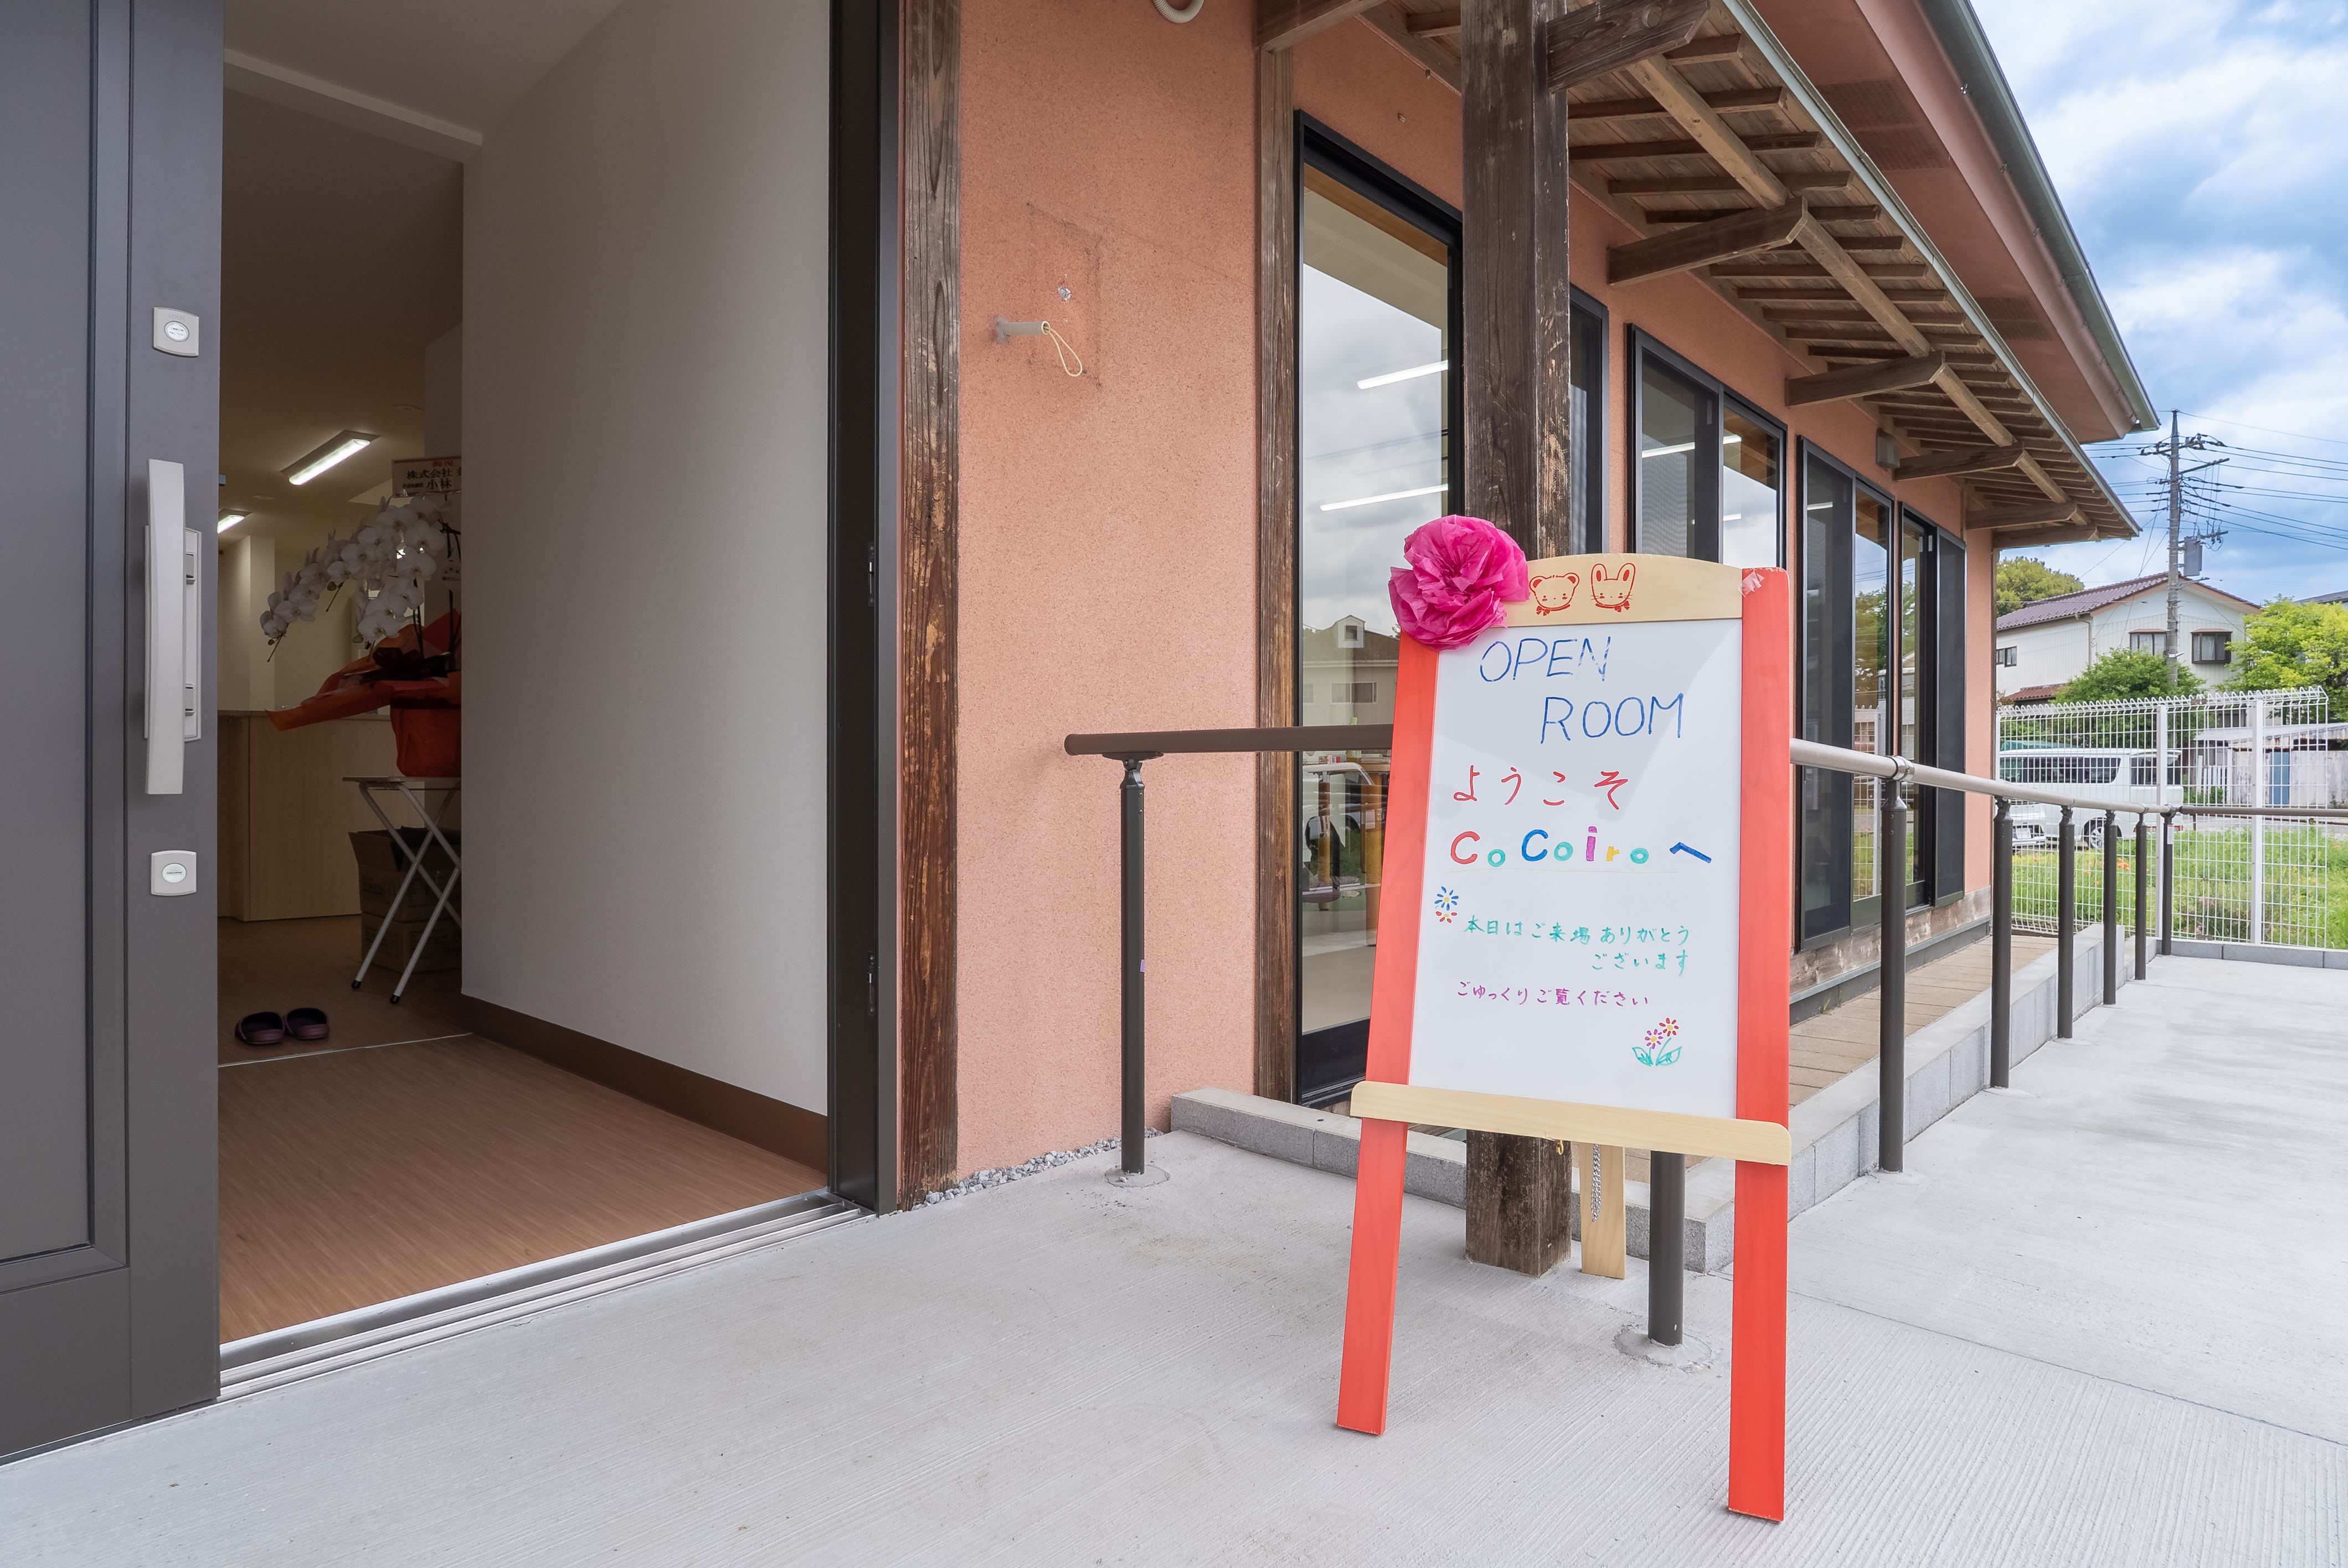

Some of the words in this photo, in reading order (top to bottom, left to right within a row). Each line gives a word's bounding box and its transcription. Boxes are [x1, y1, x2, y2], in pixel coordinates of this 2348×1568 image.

[406, 468, 453, 479] 株式会社
[426, 478, 452, 489] 小林
[1480, 636, 1611, 682] OPEN
[1541, 693, 1684, 744] ROOM
[1454, 765, 1629, 810] ようこそ
[1592, 949, 1688, 976] ございます
[1458, 981, 1649, 1007] ごゆっくりご覧ください
